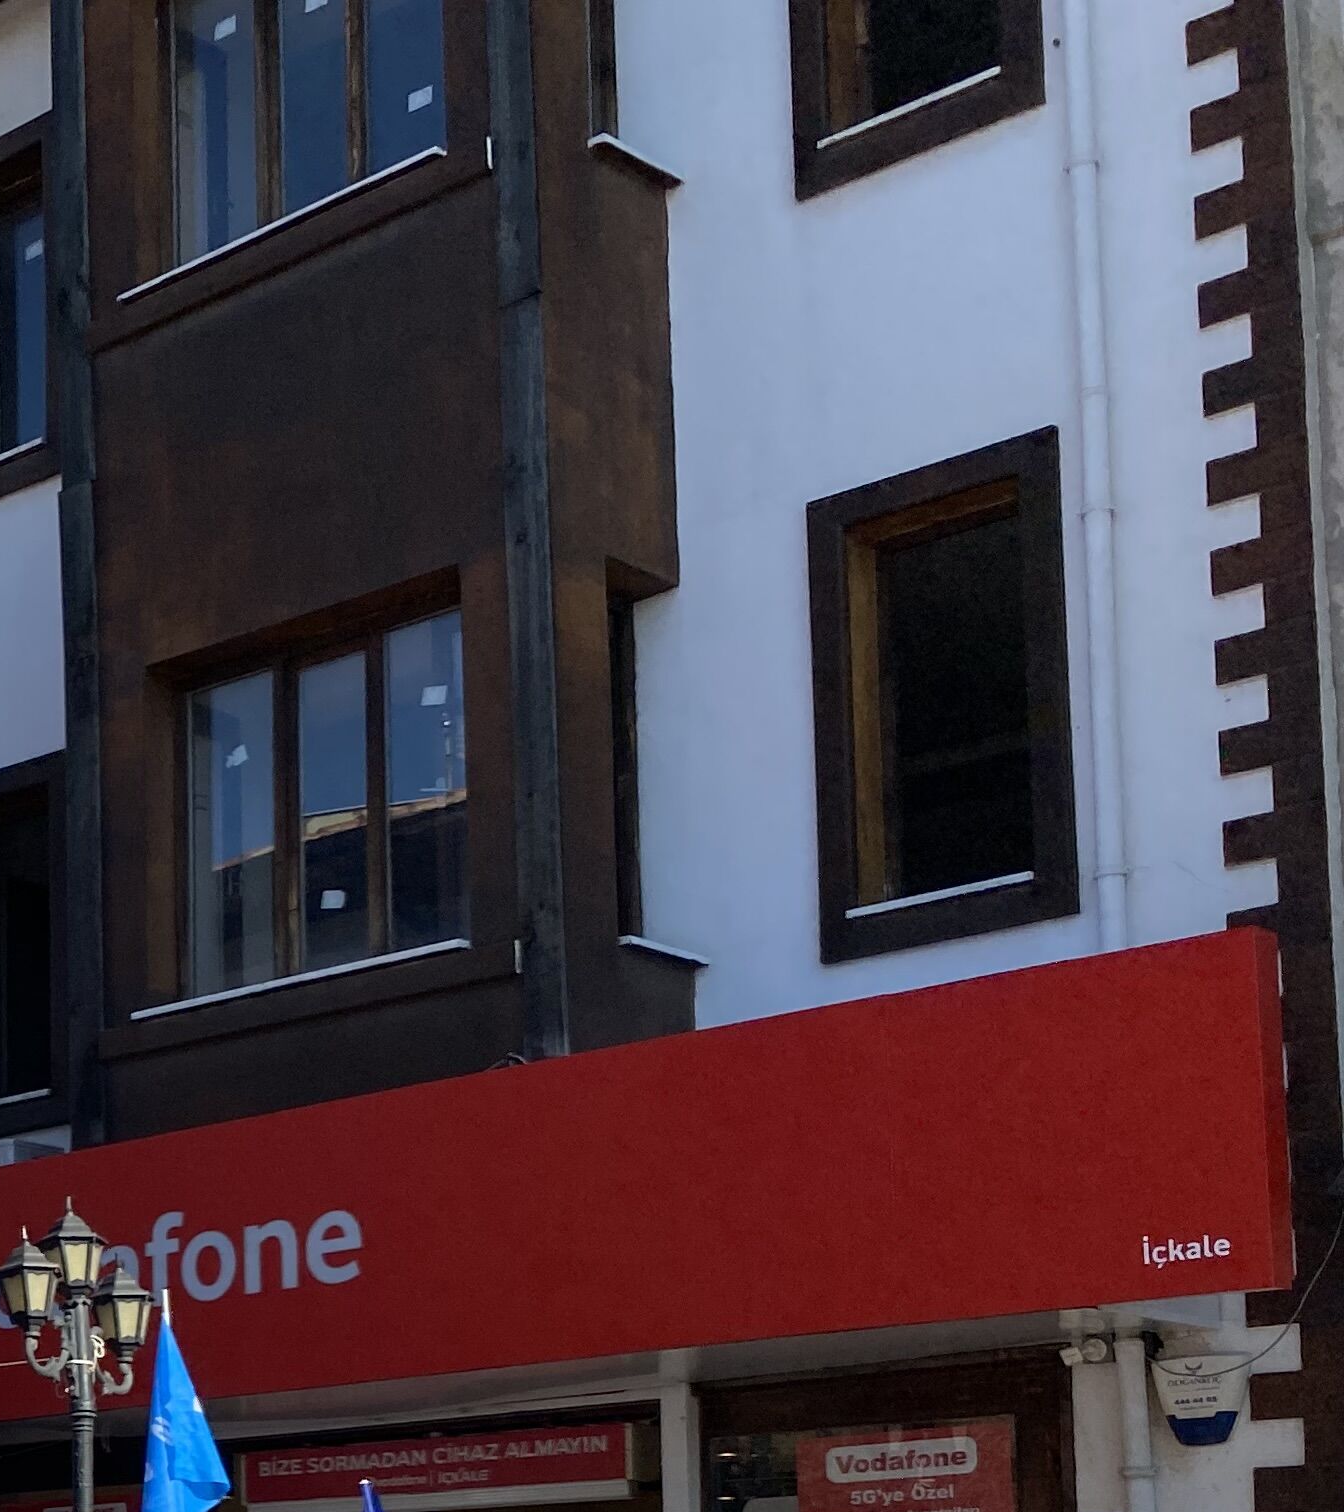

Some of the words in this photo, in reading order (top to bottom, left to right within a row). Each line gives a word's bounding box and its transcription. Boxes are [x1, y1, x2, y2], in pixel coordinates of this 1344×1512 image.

[1142, 1234, 1231, 1269] İçkale
[257, 1455, 303, 1477] BİZE
[306, 1448, 427, 1473] SORMADAN
[432, 1442, 499, 1465] CİHAZ
[505, 1434, 609, 1459] ALMAYIN
[835, 1449, 968, 1475] Vodafone
[850, 1489, 905, 1506] 5G'ye
[912, 1482, 955, 1501] Özel
